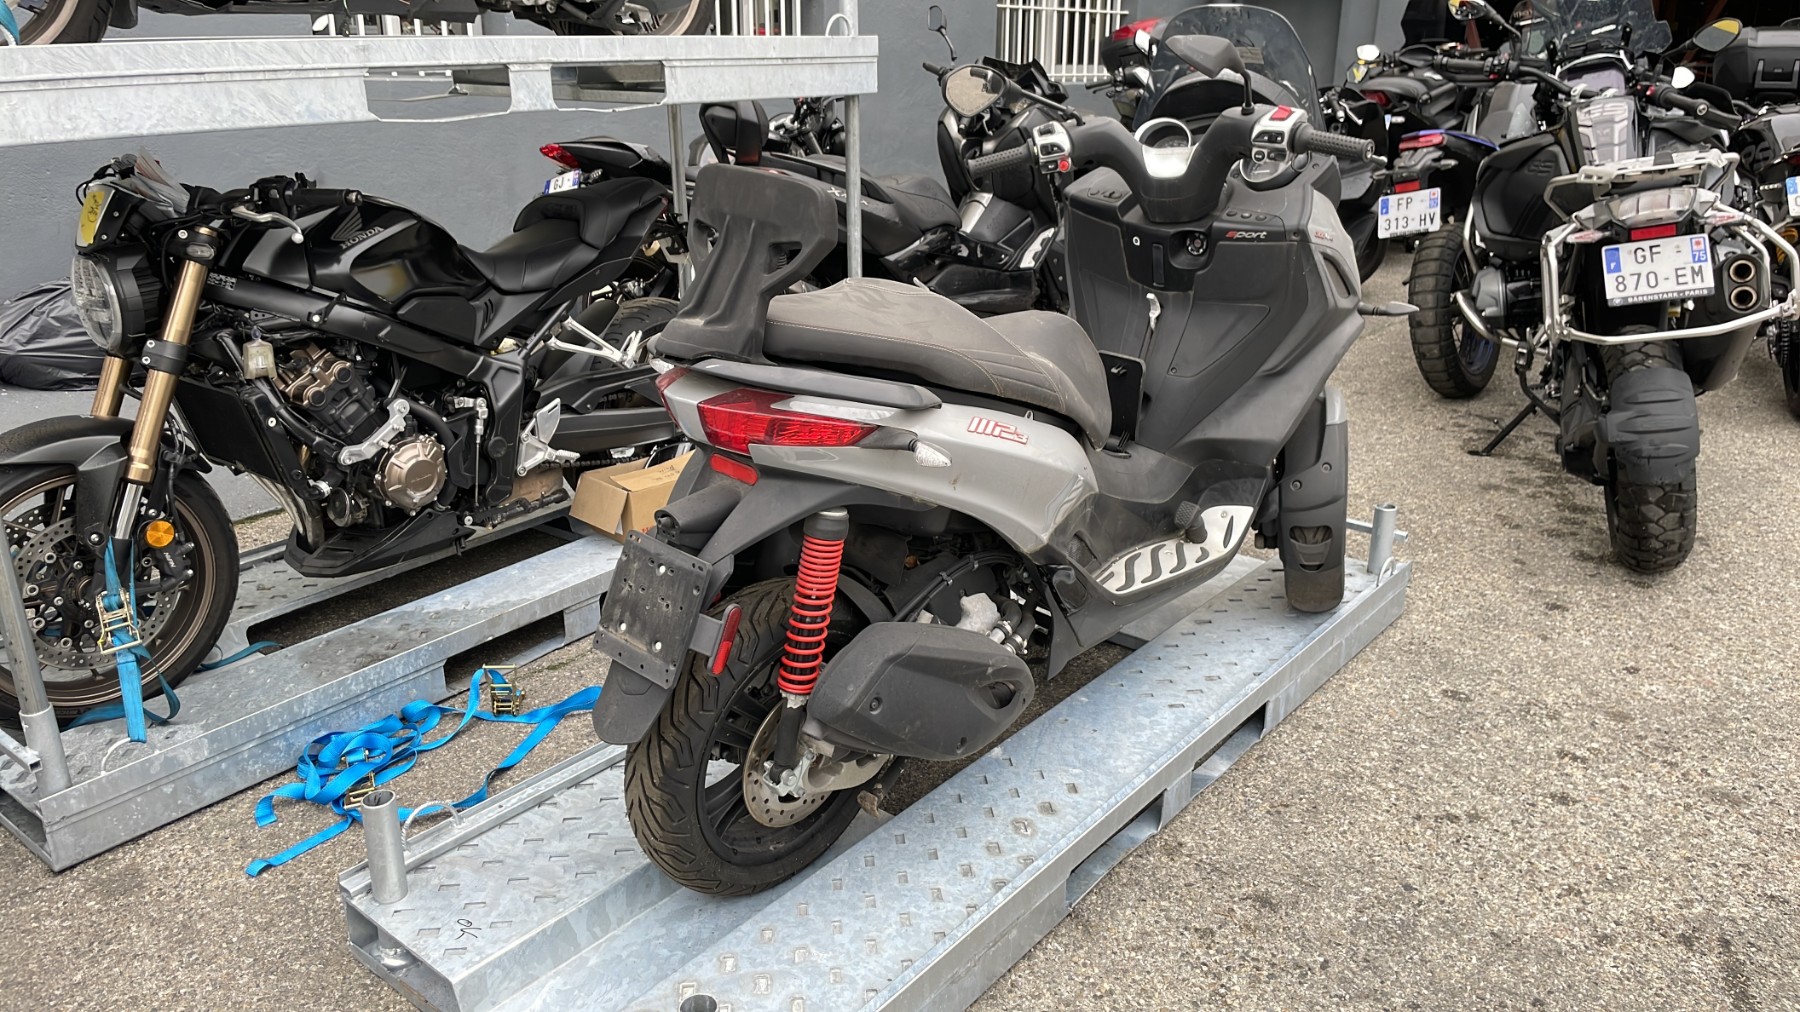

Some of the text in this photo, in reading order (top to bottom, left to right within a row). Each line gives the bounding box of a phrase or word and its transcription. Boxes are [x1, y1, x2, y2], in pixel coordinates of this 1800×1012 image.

[1396, 196, 1413, 211] FP
[340, 226, 385, 250] HONDA
[1633, 244, 1661, 264] GF
[1693, 250, 1707, 262] 75
[1684, 288, 1708, 297] PARIS
[454, 918, 482, 941] OK
